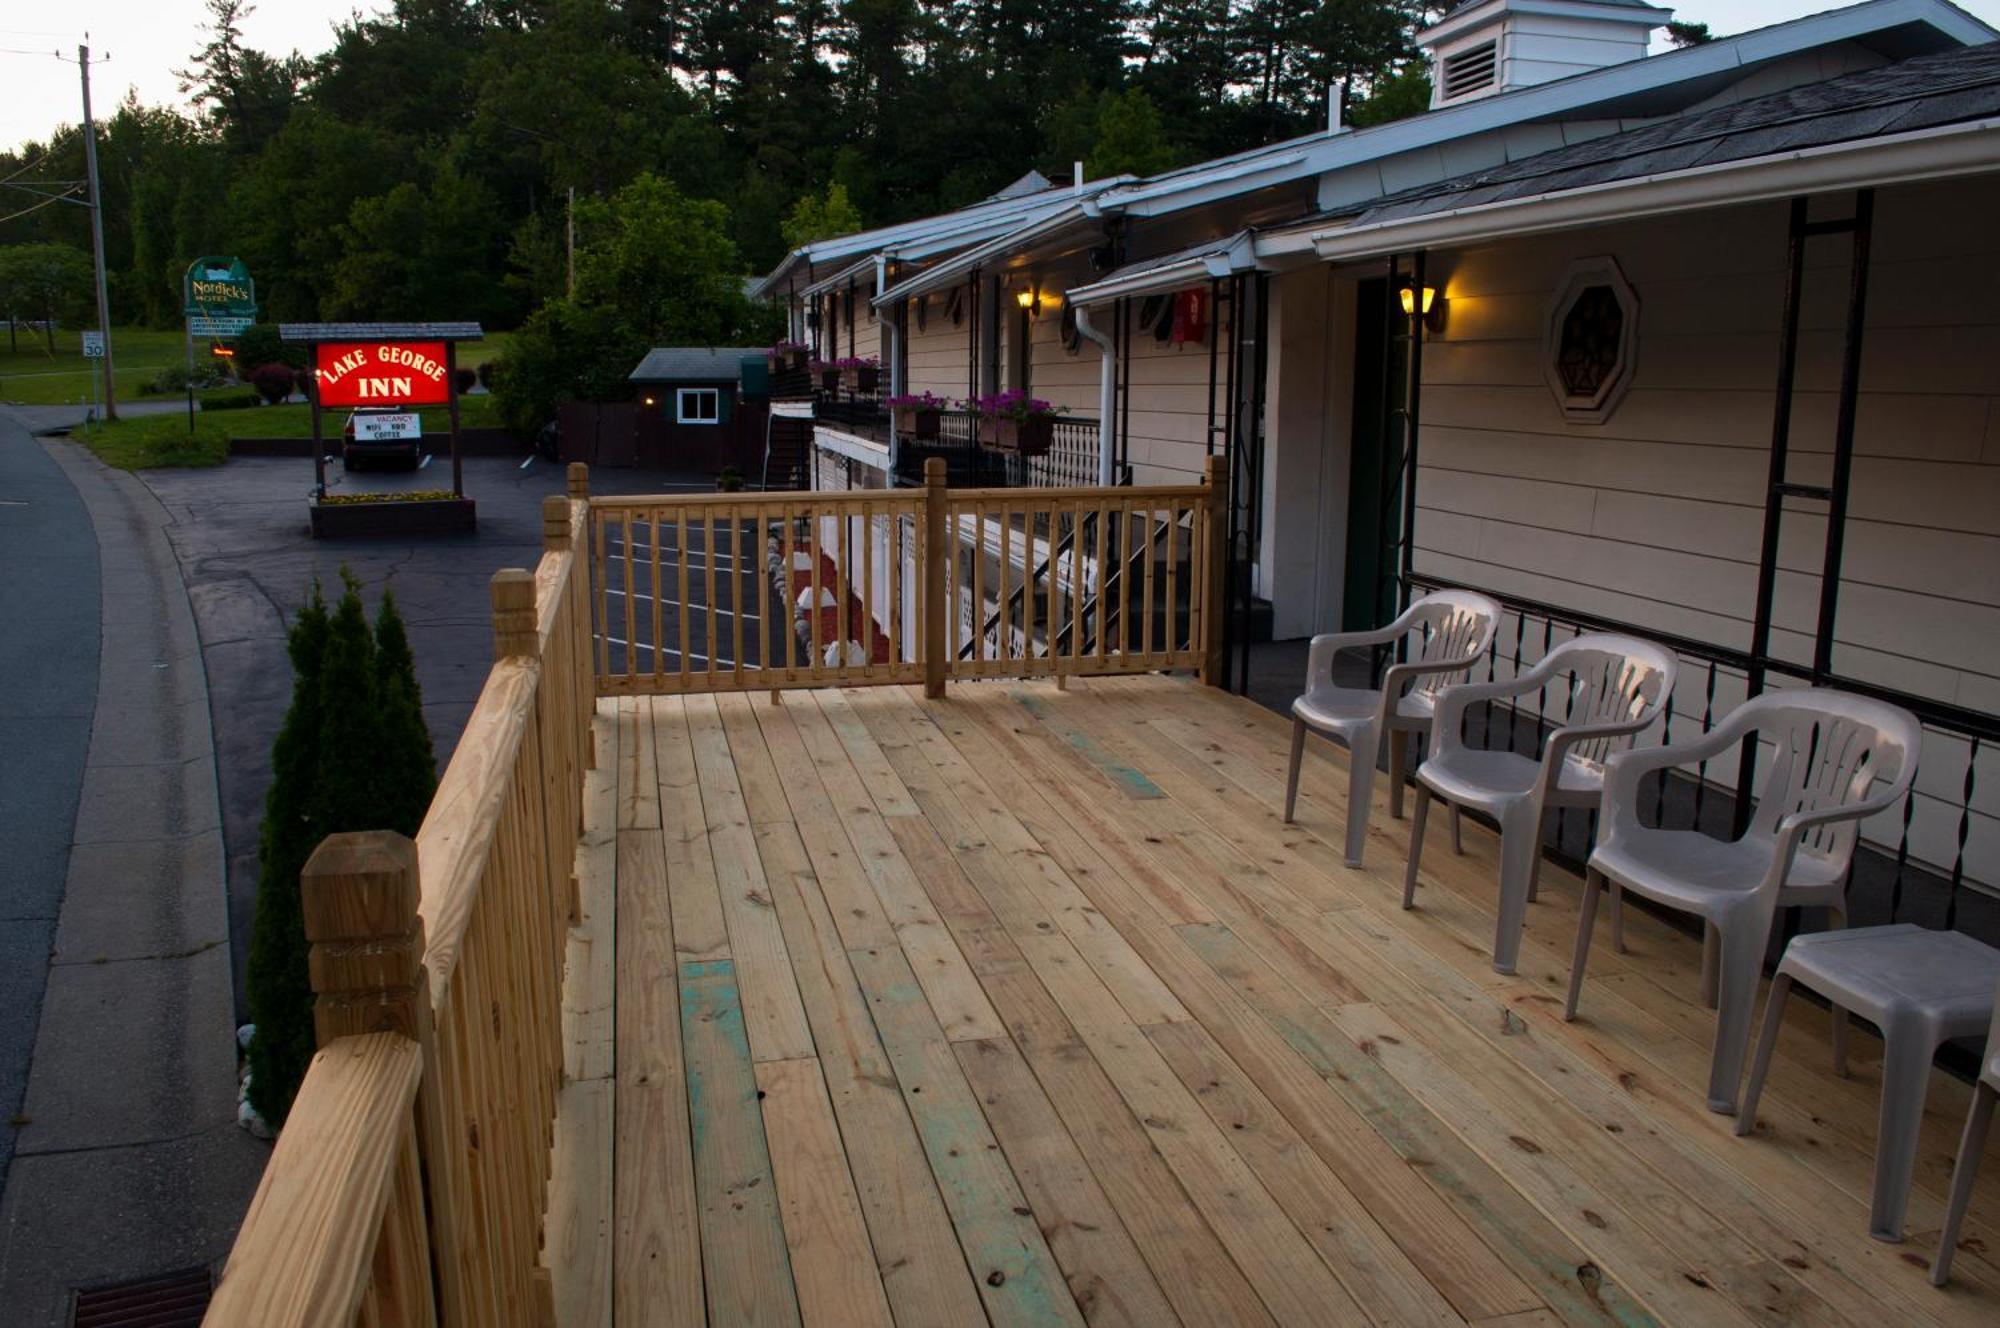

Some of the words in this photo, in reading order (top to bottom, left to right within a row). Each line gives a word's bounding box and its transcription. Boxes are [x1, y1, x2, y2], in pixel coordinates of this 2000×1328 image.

[192, 281, 248, 300] Nordick's
[86, 346, 103, 355] 30
[323, 350, 367, 384] LAKE
[378, 346, 446, 381] GEORGE
[358, 377, 412, 398] INN
[376, 415, 413, 424] VACANCY
